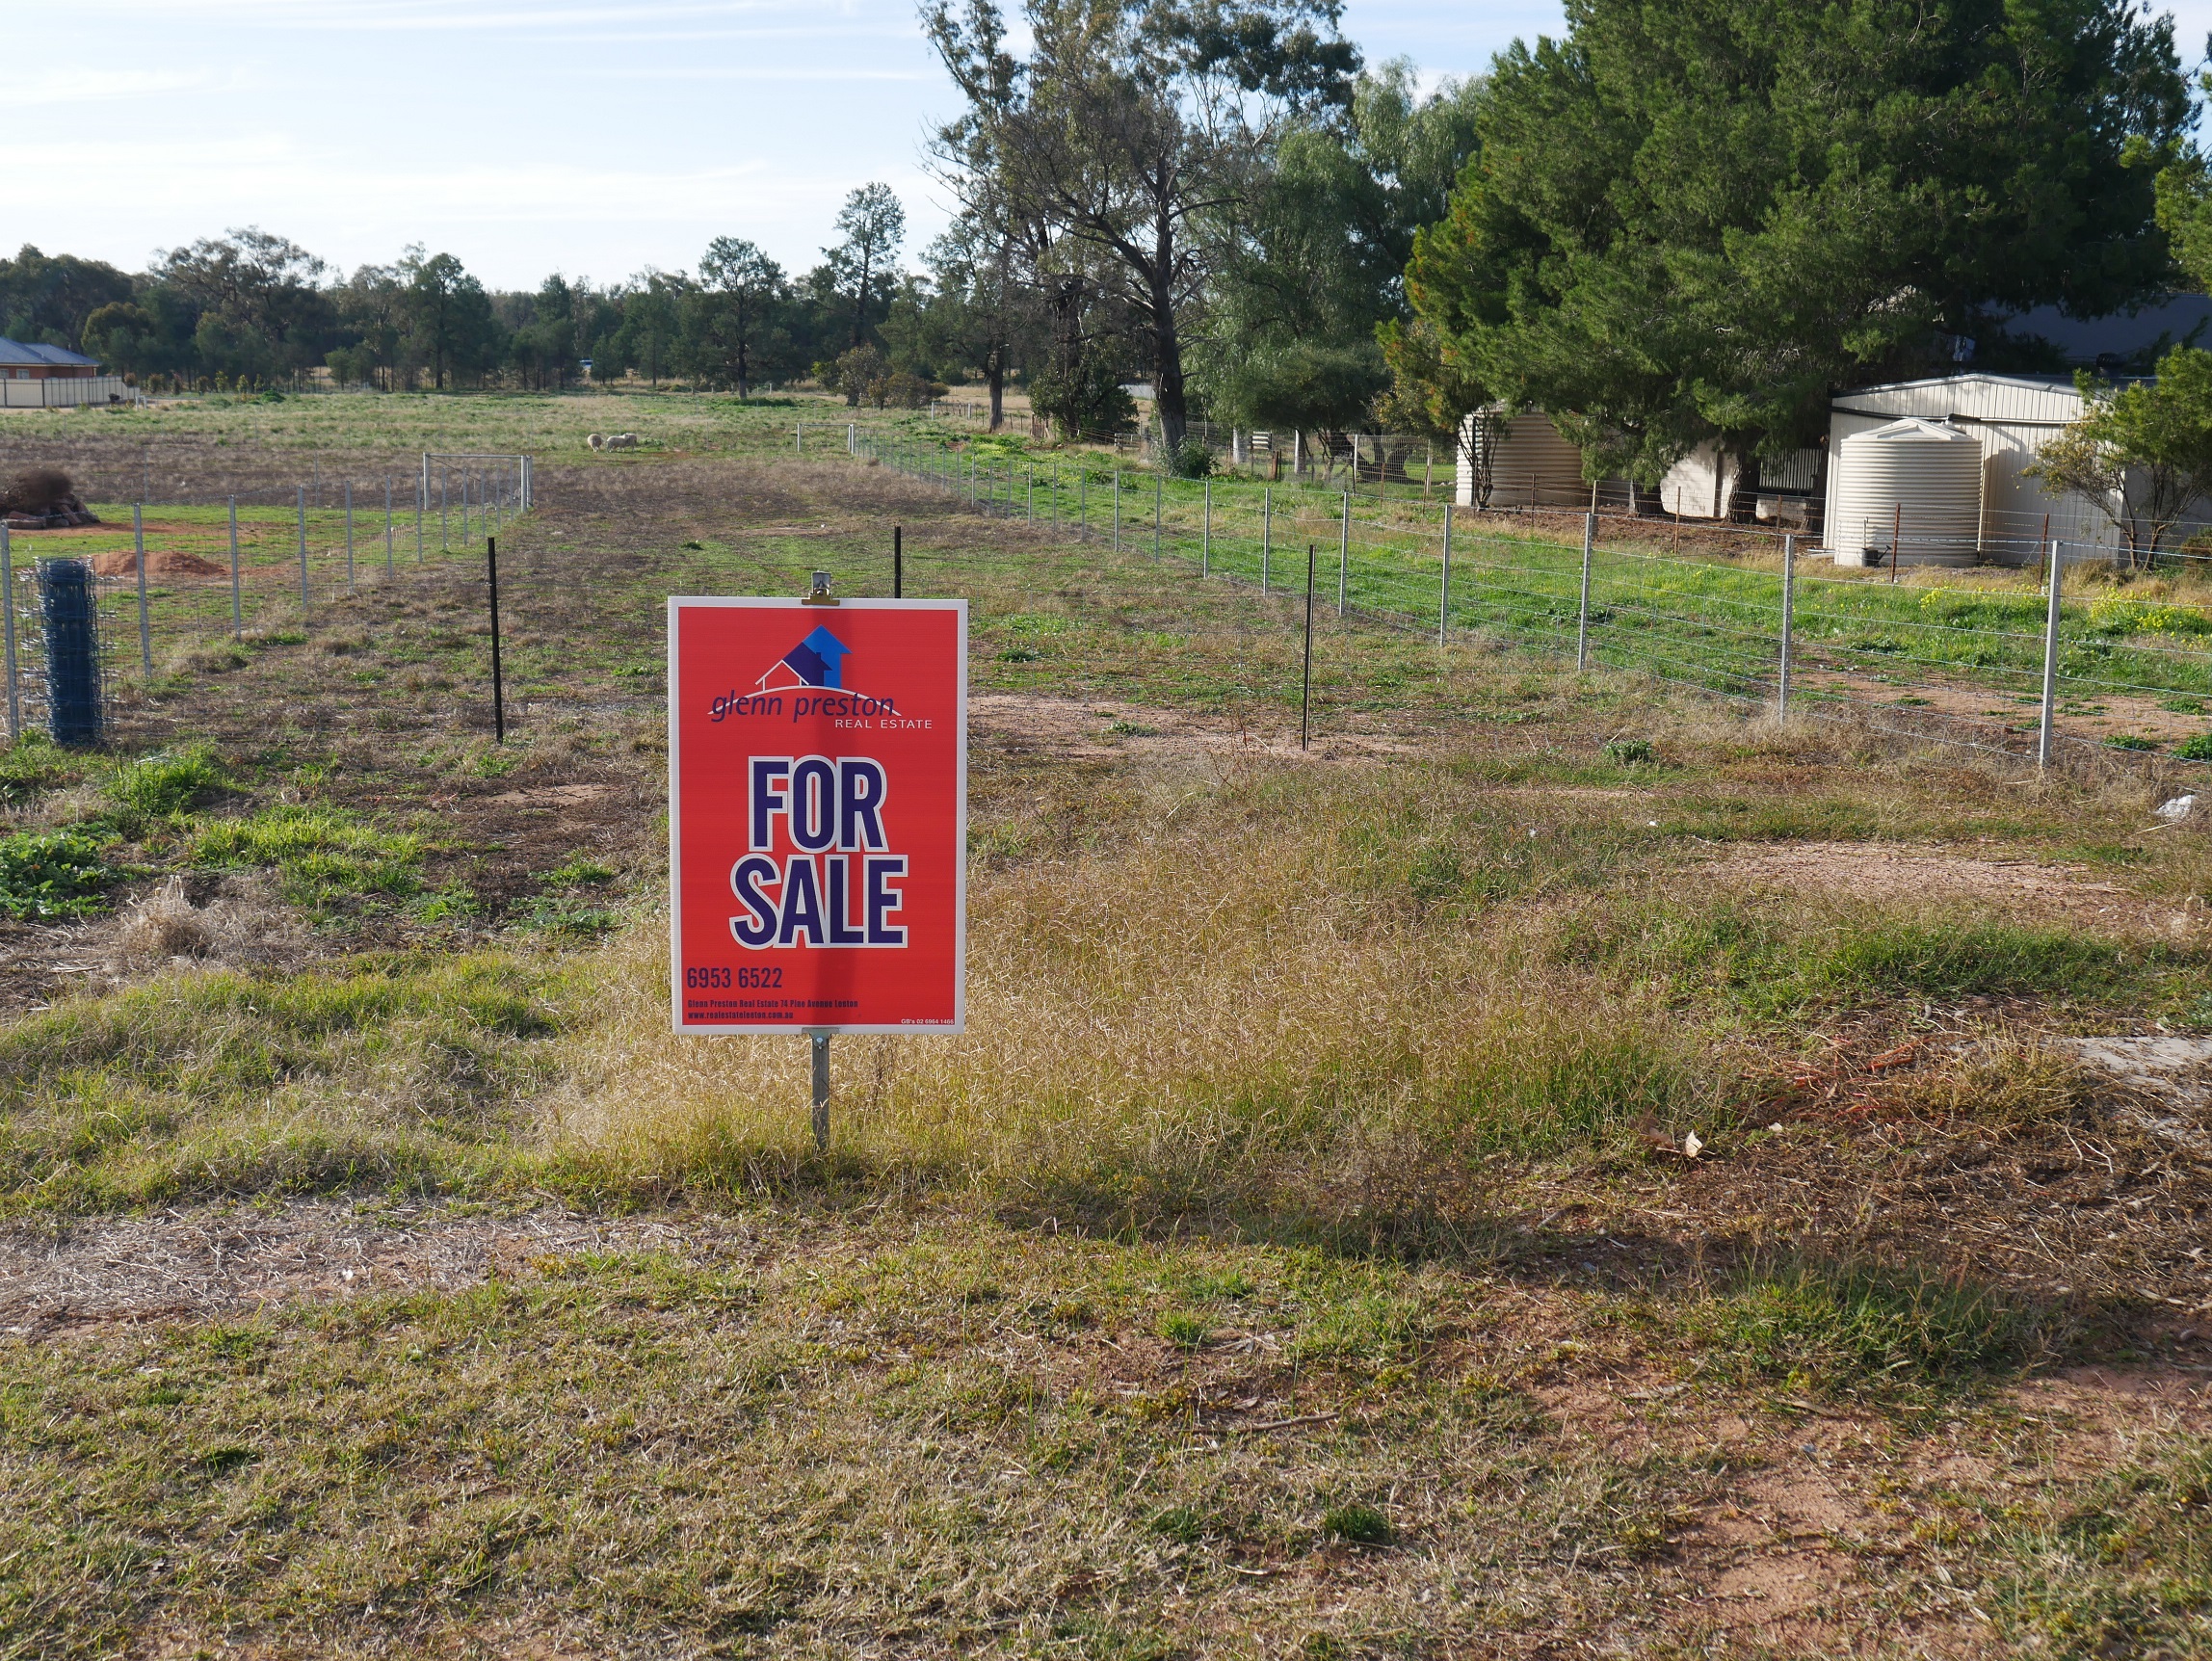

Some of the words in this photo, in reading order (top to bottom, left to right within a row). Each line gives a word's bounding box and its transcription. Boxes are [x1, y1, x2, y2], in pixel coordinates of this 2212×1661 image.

[711, 689, 783, 723] glenn
[793, 693, 894, 724] preston
[834, 719, 872, 728] REAL
[881, 719, 933, 729] ESTATE
[749, 754, 889, 854] FOR
[729, 853, 908, 950] SALE
[686, 966, 731, 989] 6953
[738, 966, 782, 989] 6522
[687, 999, 708, 1008] Glenn
[710, 999, 738, 1008] Preston
[739, 999, 755, 1008] Real
[756, 999, 779, 1008] Estate
[780, 999, 788, 1008] 74
[790, 999, 805, 1008] Pine
[807, 999, 833, 1008] Avenue
[834, 999, 858, 1008] Leeton
[688, 1011, 794, 1019] www.realestateleeton.com.au
